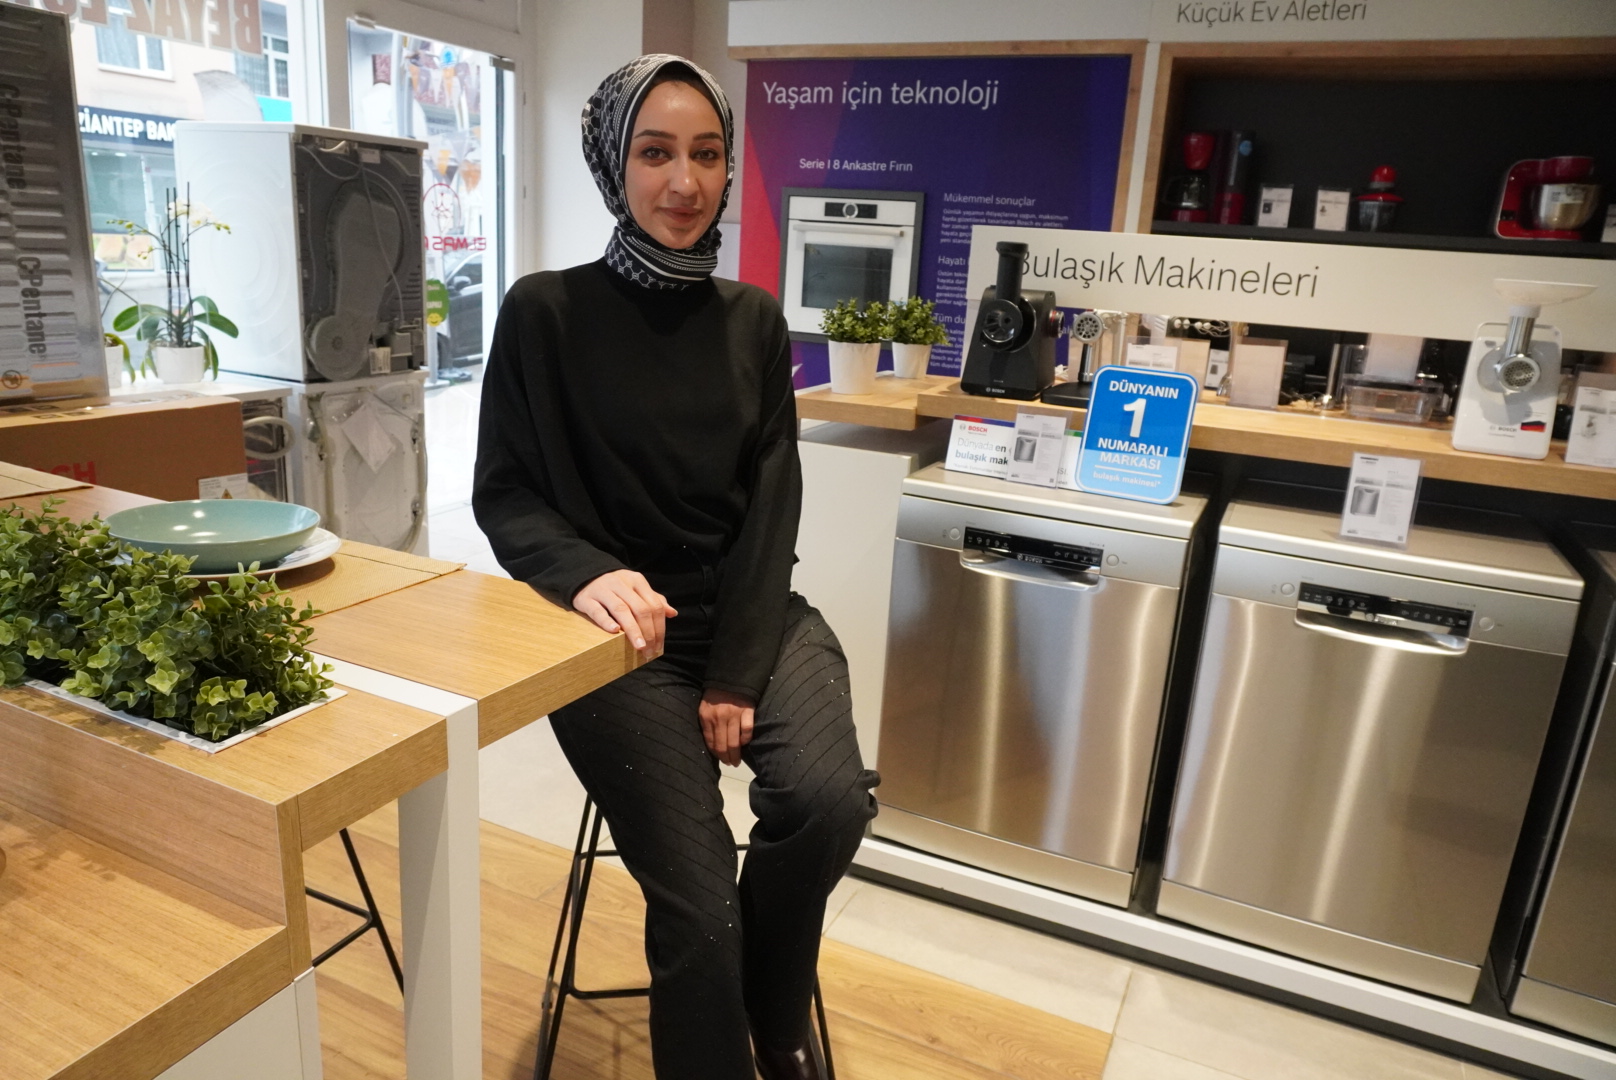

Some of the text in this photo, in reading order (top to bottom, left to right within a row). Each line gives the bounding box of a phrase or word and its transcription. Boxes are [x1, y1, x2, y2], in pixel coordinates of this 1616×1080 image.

[1177, 0, 1366, 28] Küçük Ev Aletleri
[763, 80, 999, 110] Yaşam için teknoloji
[799, 158, 825, 170] Serie
[833, 159, 841, 170] 8
[842, 159, 887, 171] Ankastre
[889, 160, 913, 172] Fırın
[943, 192, 1036, 208] Mükemmel sonuçlar
[1038, 213, 1069, 221] maksimum
[937, 255, 966, 267] Hayatı
[1134, 254, 1320, 298] Makineleri
[933, 311, 953, 323] Tüm
[930, 354, 947, 362] Bosch
[1109, 379, 1179, 399] DÜNYANIN
[1123, 398, 1147, 438] 1
[968, 425, 988, 433] BOSCH
[957, 437, 994, 451] Dünyada
[995, 444, 1007, 453] en
[1097, 437, 1168, 457] NUMARALI
[955, 449, 987, 463] bulaşık
[1100, 451, 1161, 470] MARKASI
[1093, 470, 1120, 482] bulaşık
